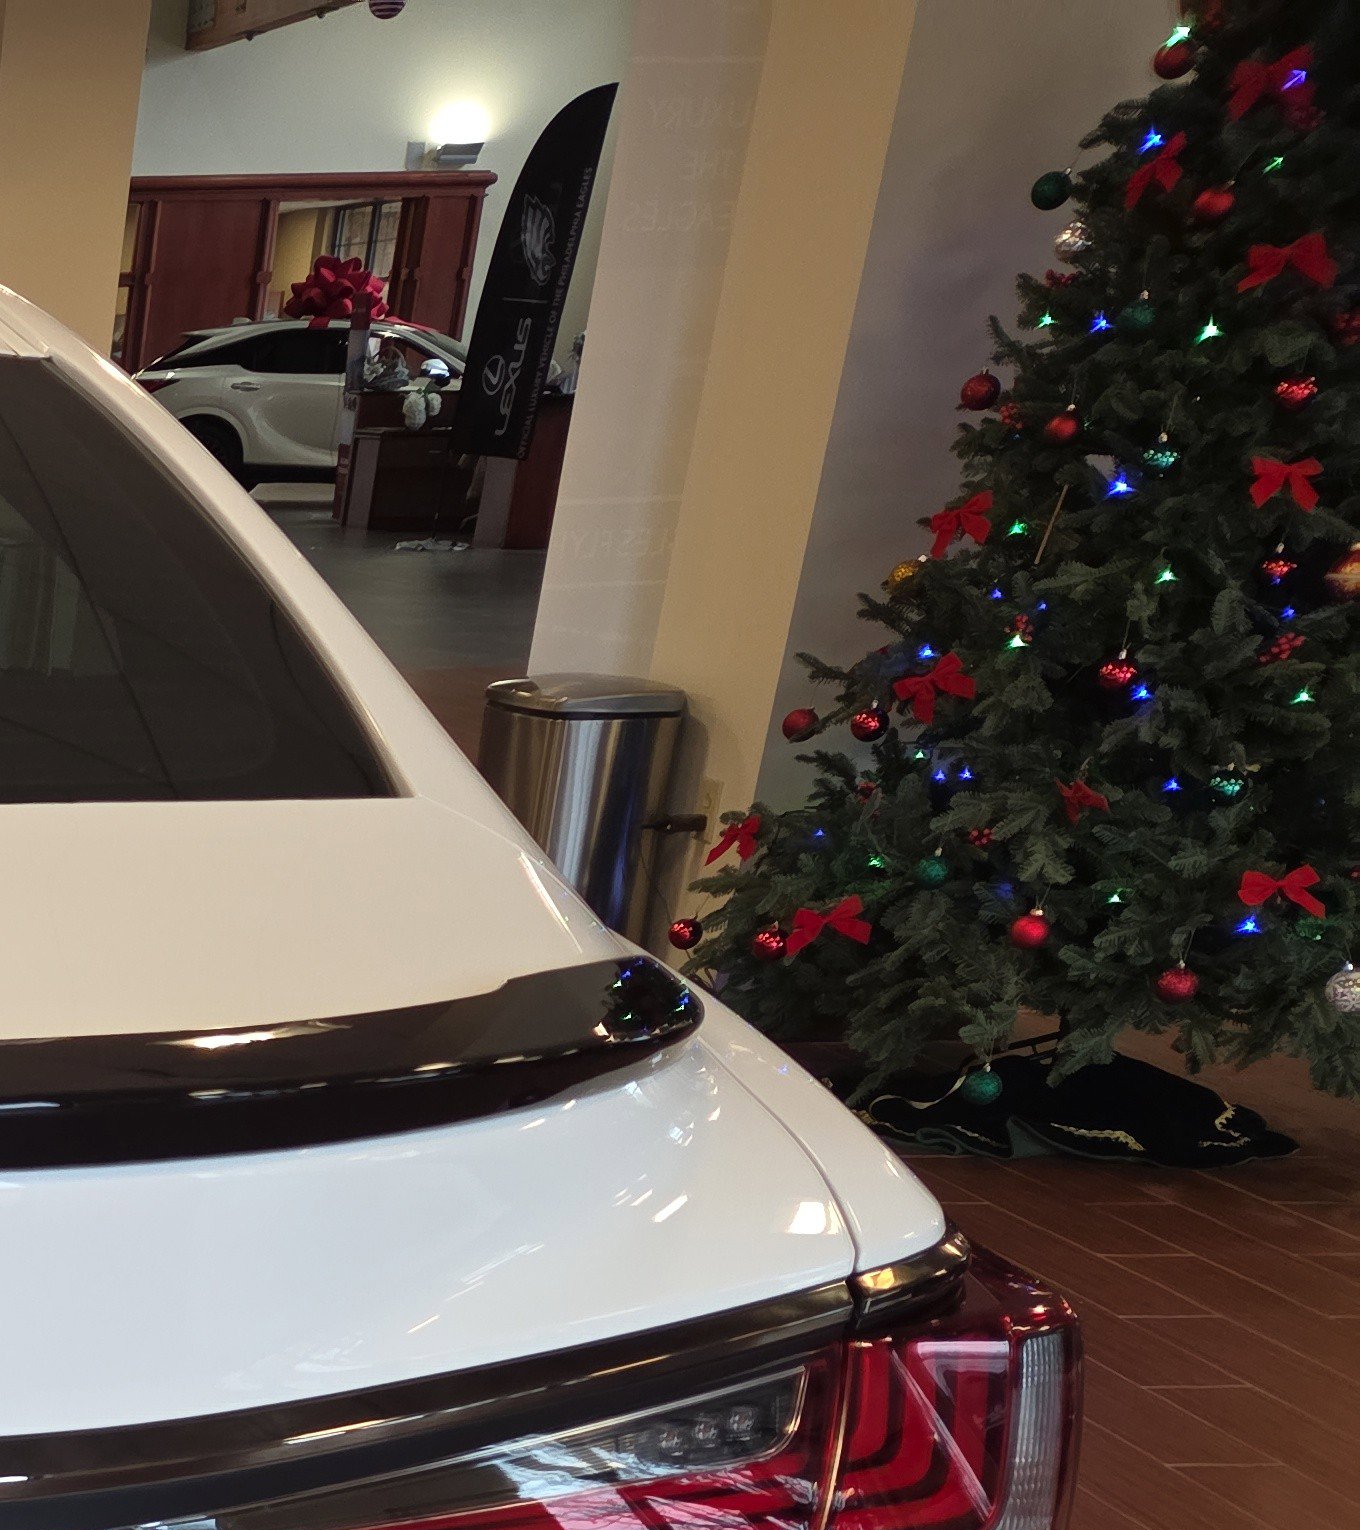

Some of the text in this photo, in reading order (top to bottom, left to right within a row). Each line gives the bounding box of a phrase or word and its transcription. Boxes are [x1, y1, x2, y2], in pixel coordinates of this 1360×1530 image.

[556, 210, 582, 286] PHILADELPHIA
[576, 166, 593, 208] EAGLES
[494, 317, 532, 436] LEXUS
